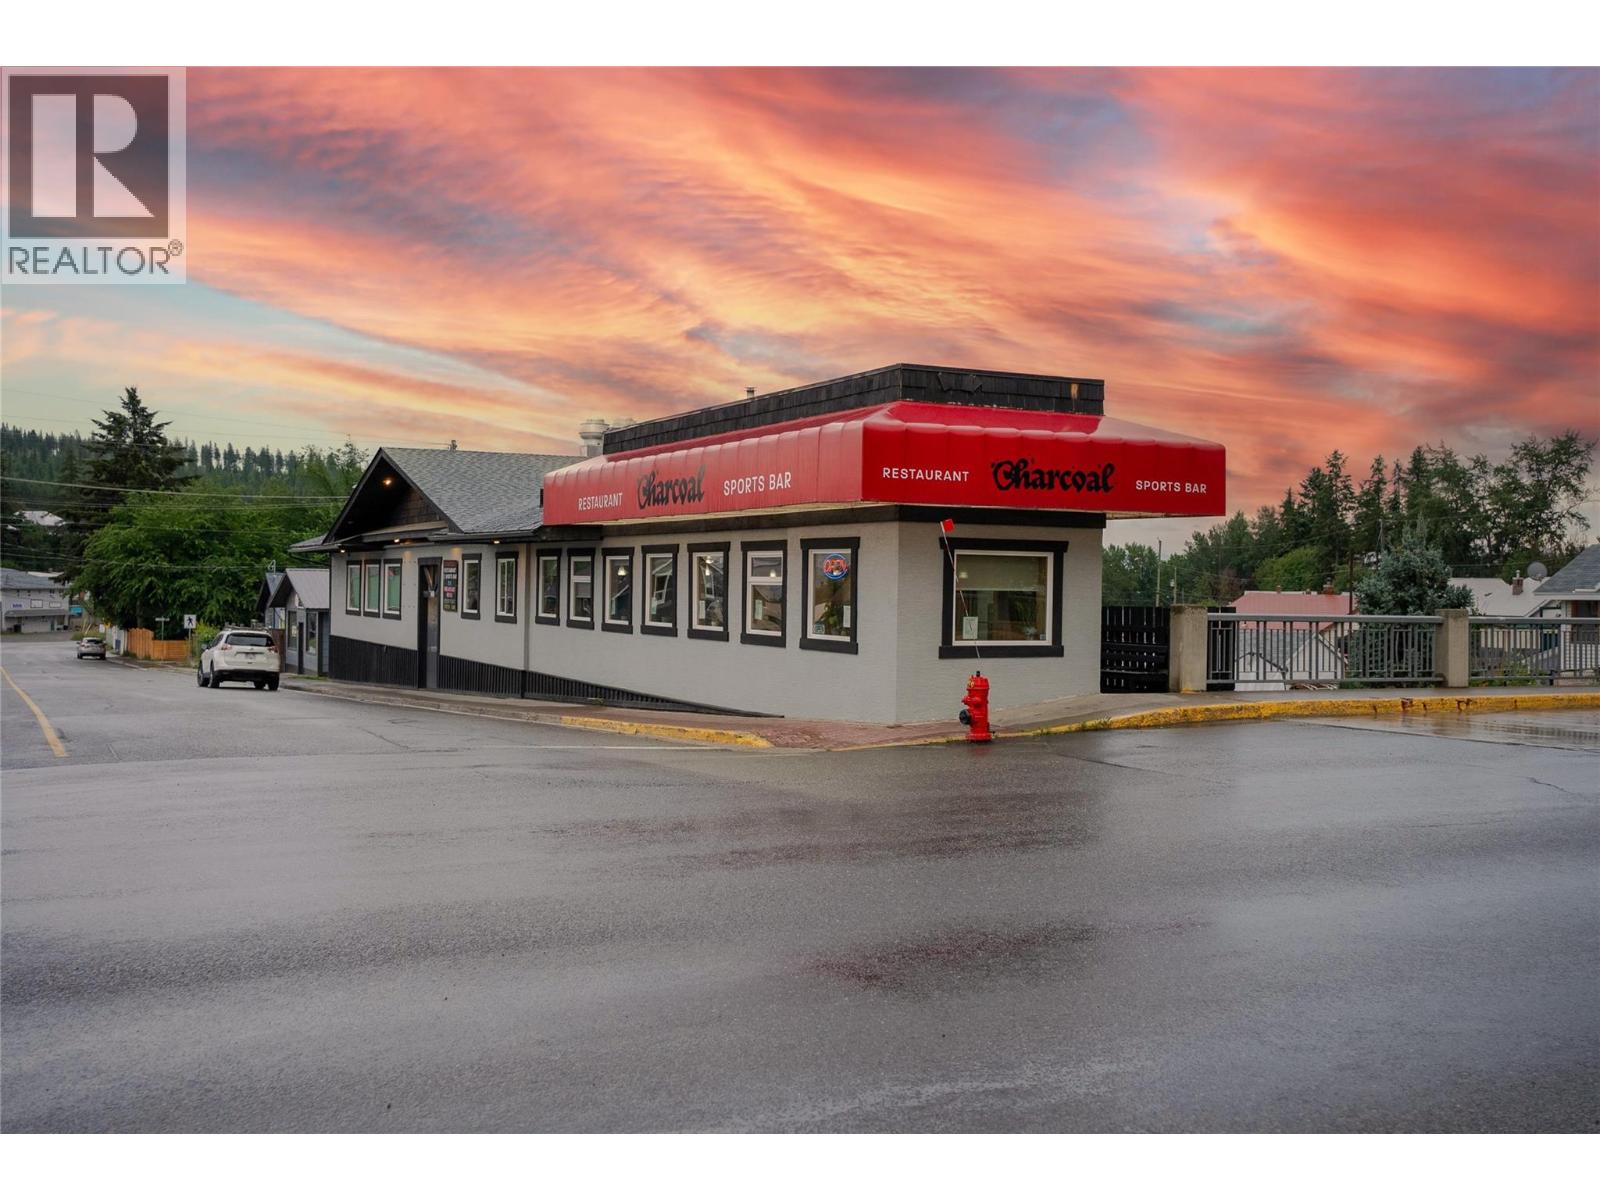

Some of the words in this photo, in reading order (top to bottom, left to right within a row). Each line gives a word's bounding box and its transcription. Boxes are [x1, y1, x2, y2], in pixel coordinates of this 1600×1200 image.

[578, 492, 623, 511] RESTAURANT
[636, 464, 706, 511] Charcoal
[723, 475, 765, 496] SPORTS
[769, 471, 792, 490] BAR
[882, 467, 969, 482] RESTAURANT
[992, 458, 1115, 492] Charcoal
[1135, 479, 1181, 493] SPORTS
[1185, 482, 1207, 494] BAR
